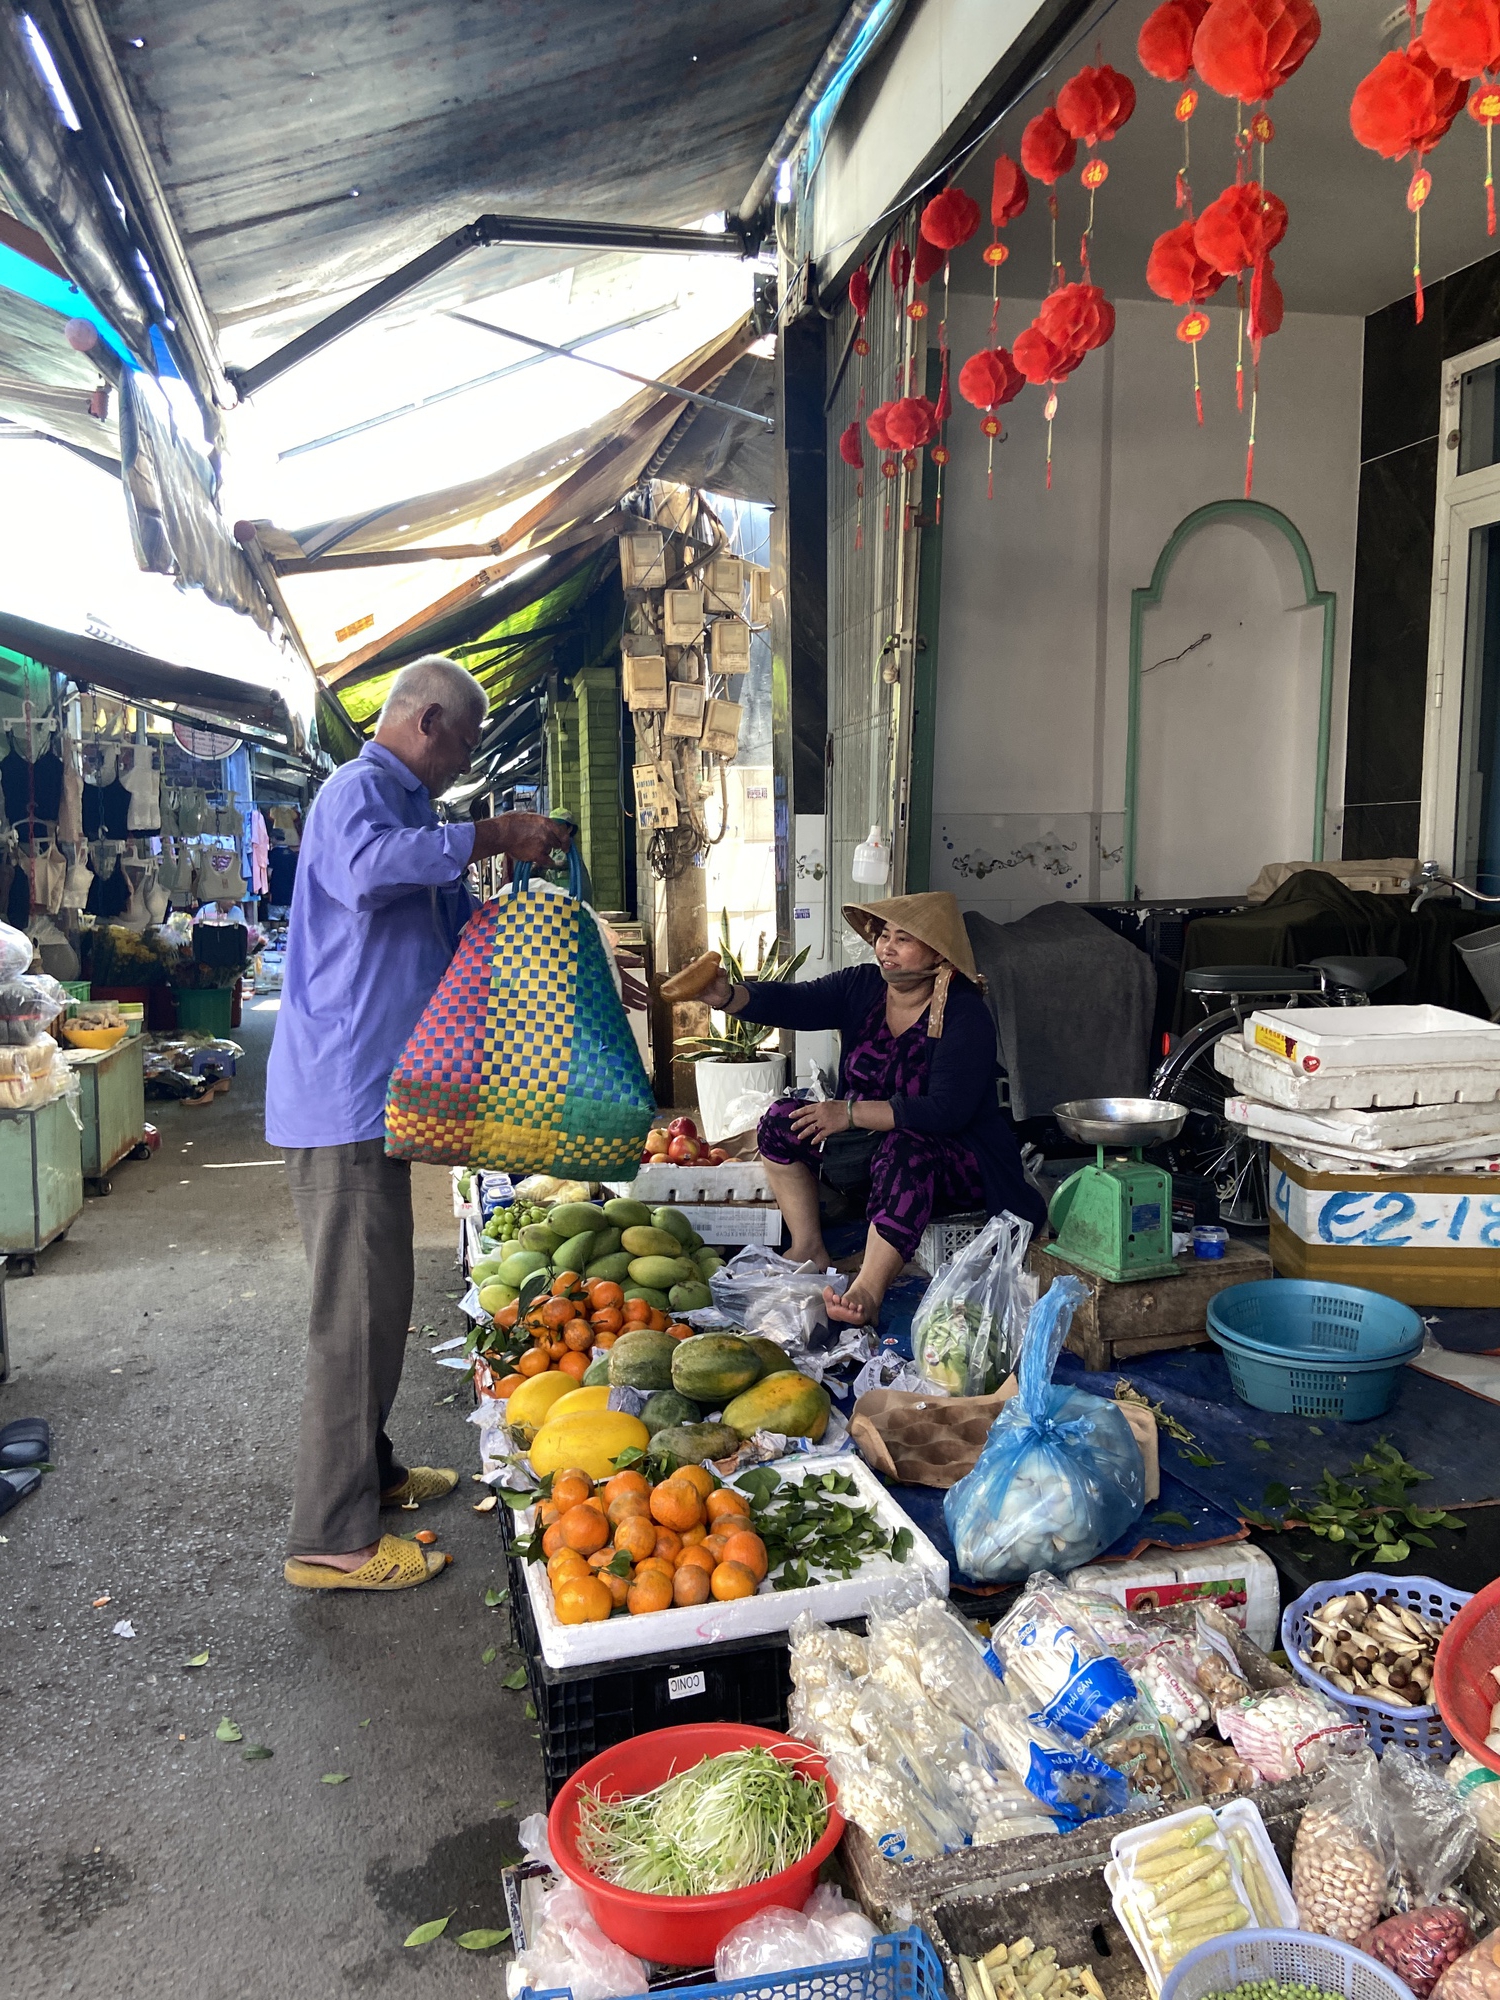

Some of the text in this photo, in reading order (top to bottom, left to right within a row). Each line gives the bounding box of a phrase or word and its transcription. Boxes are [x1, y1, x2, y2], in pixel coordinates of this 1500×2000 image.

[671, 1674, 700, 1692] CONIC
[1077, 1677, 1094, 1695] SẢN
[1156, 1662, 1171, 1680] Linh
[1169, 1677, 1183, 1694] Chi
